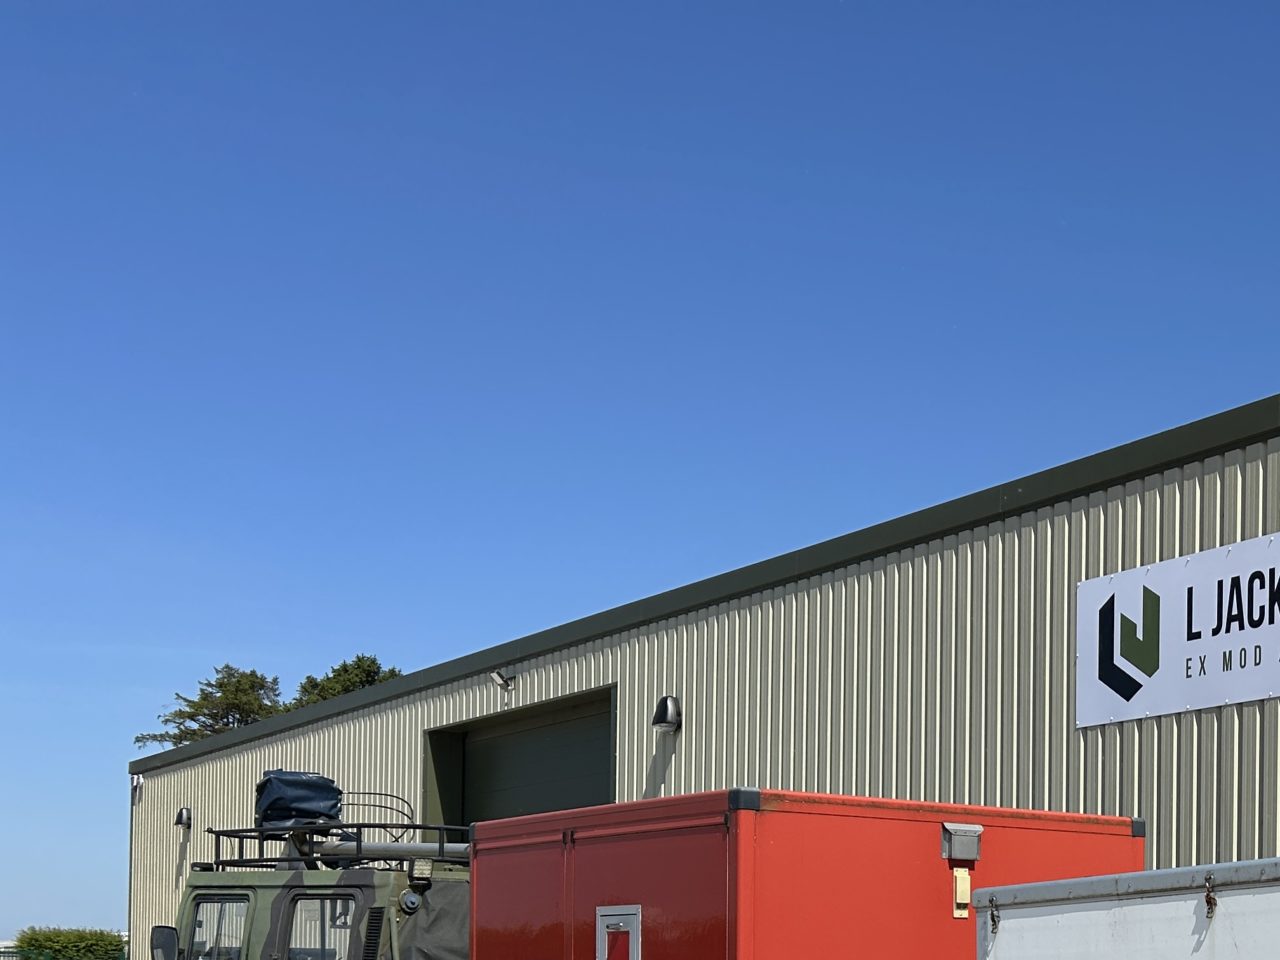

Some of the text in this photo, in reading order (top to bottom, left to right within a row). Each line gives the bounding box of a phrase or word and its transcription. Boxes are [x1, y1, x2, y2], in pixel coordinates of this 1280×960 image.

[1186, 586, 1202, 642] L
[1185, 655, 1207, 679] EX
[1222, 645, 1262, 673] MOD
